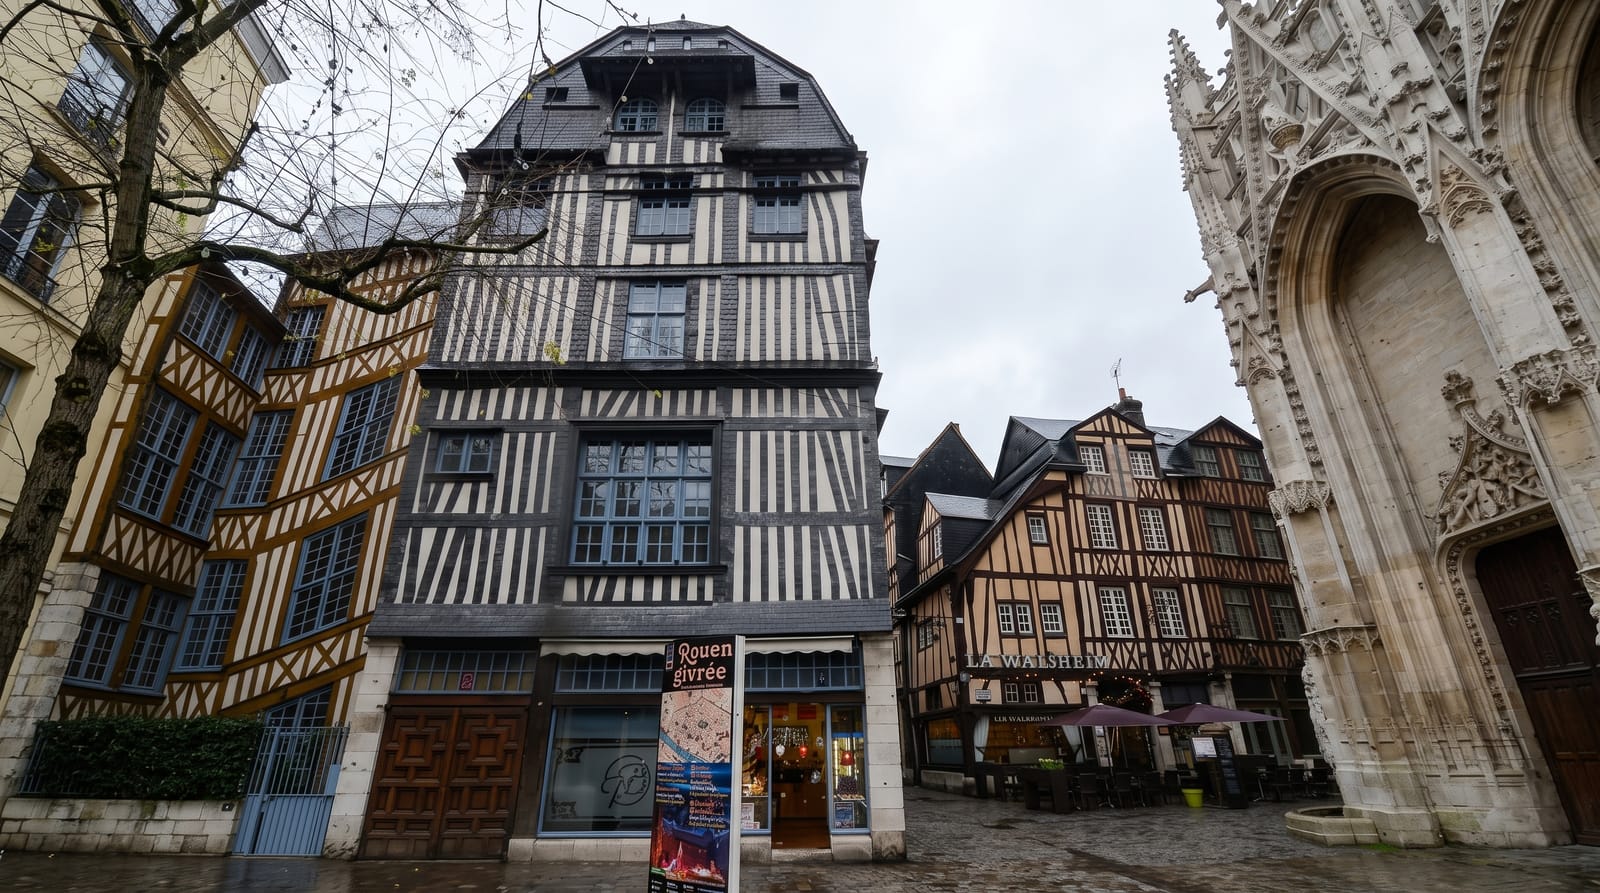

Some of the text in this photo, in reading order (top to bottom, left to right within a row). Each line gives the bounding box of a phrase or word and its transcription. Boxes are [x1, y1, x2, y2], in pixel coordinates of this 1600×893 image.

[678, 642, 733, 665] Rouen
[965, 654, 1109, 669] LA WALSHEIM
[672, 661, 727, 688] givrée
